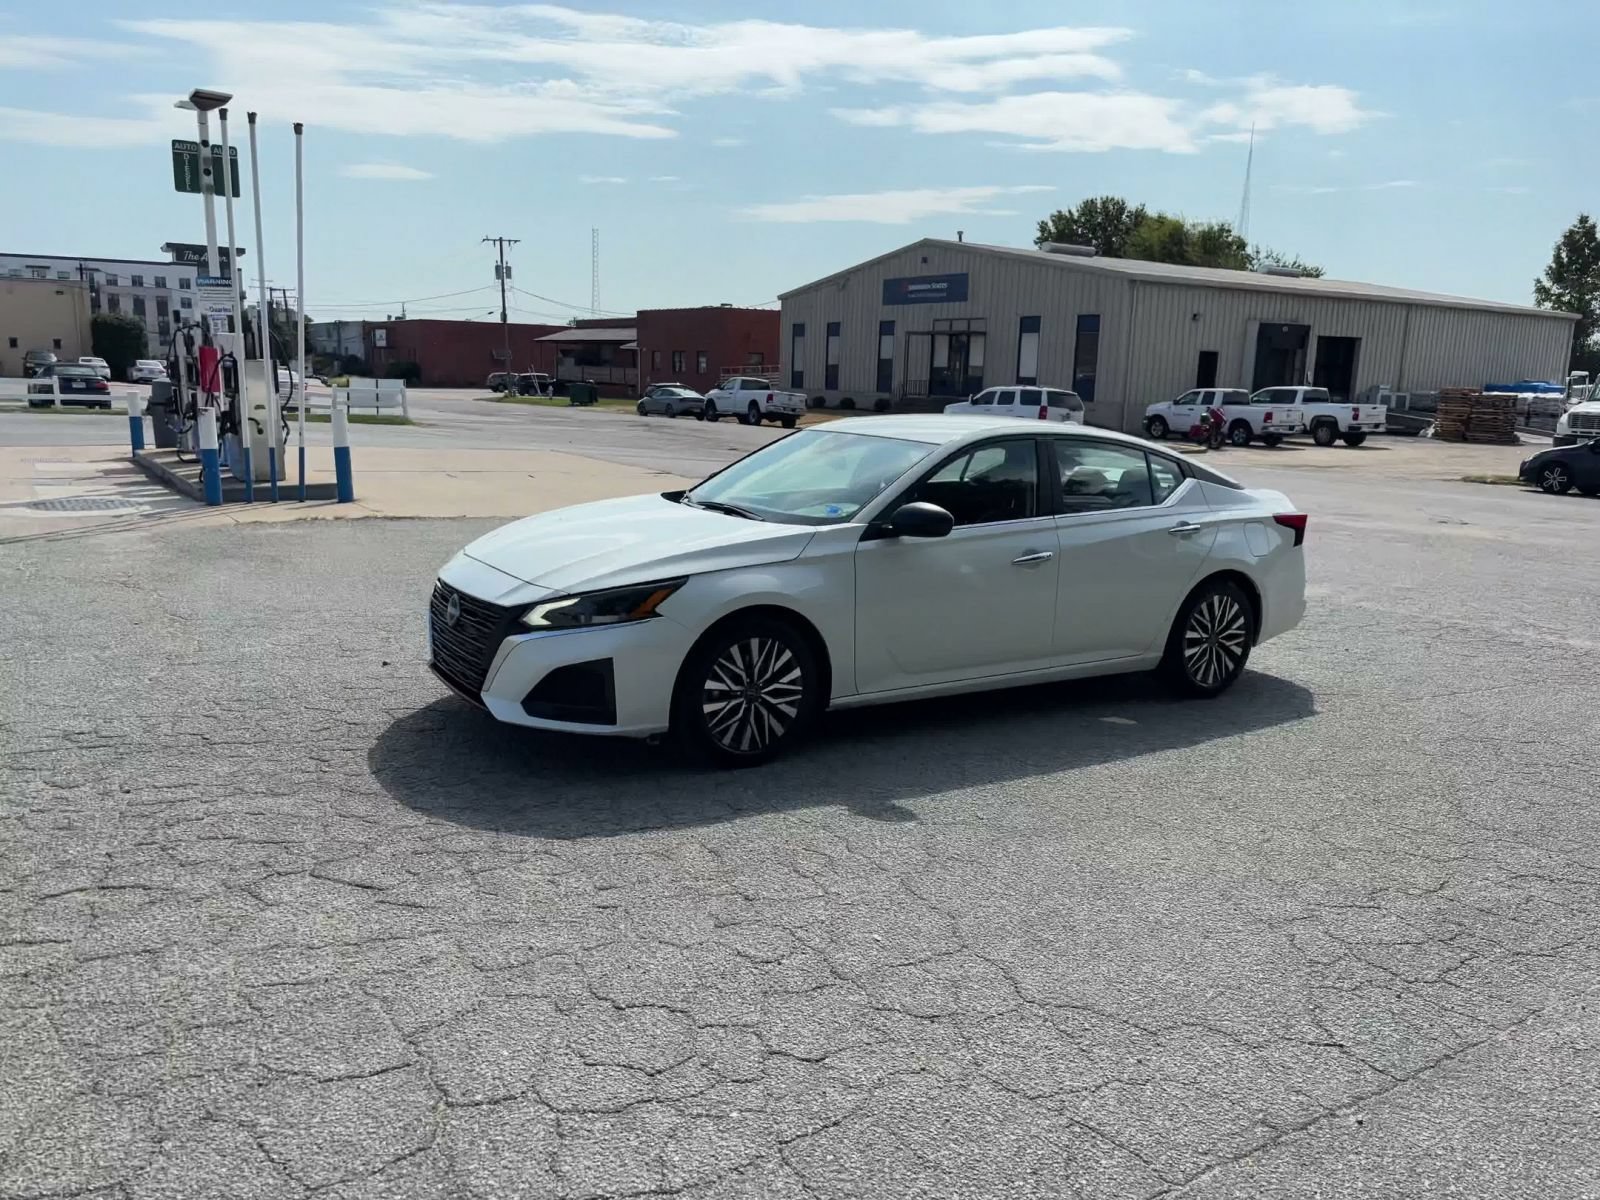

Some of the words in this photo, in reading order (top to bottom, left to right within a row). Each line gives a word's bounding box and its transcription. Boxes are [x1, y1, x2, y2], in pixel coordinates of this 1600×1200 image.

[174, 142, 197, 151] AUTO
[213, 147, 236, 156] AO
[183, 153, 191, 191] DIESEL
[183, 250, 200, 261] The
